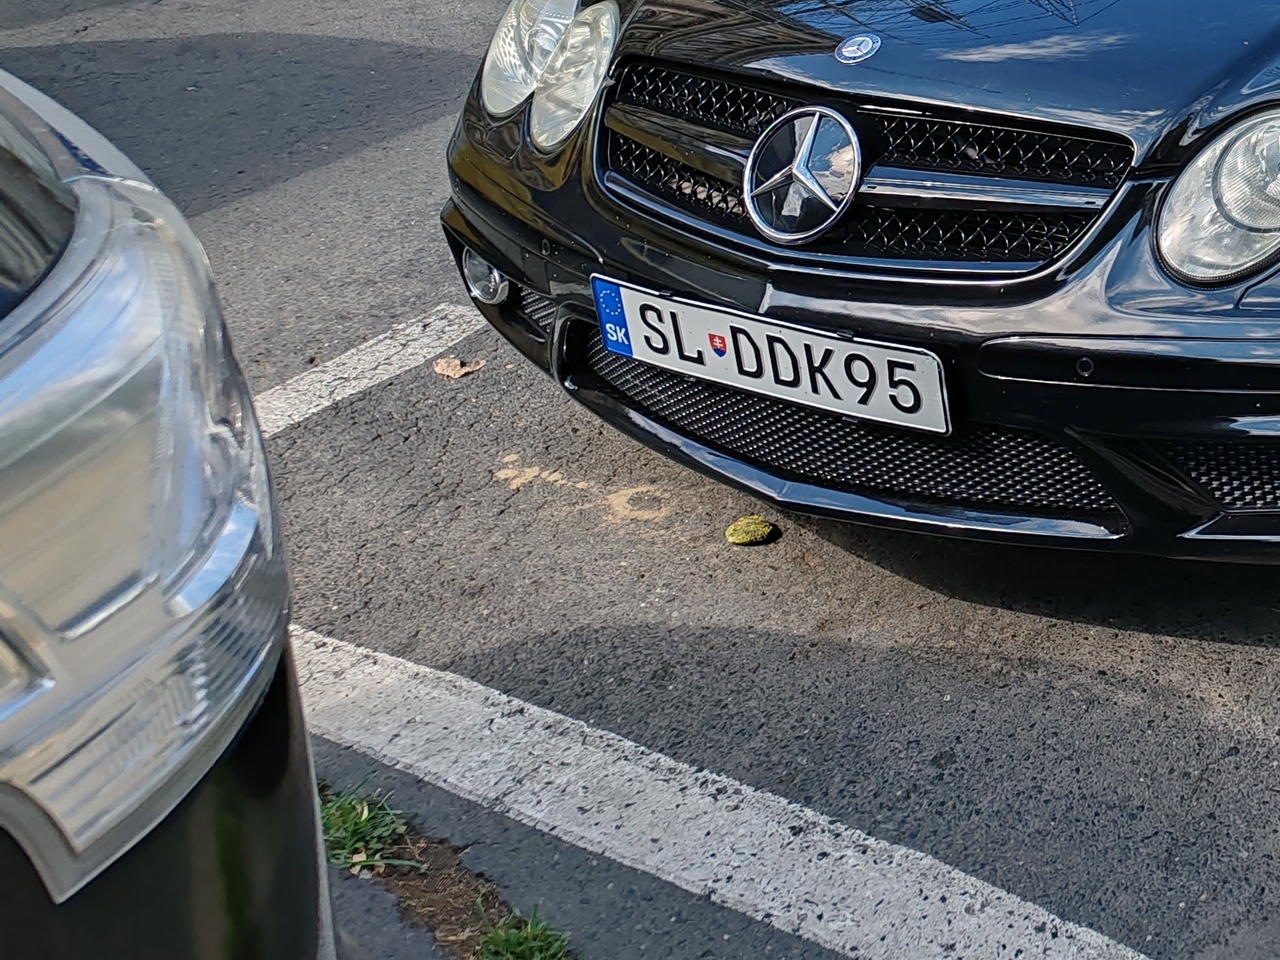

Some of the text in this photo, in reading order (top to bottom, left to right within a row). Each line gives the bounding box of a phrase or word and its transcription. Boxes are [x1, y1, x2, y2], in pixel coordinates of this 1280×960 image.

[605, 323, 629, 345] SK
[638, 303, 922, 414] SL DDK95
